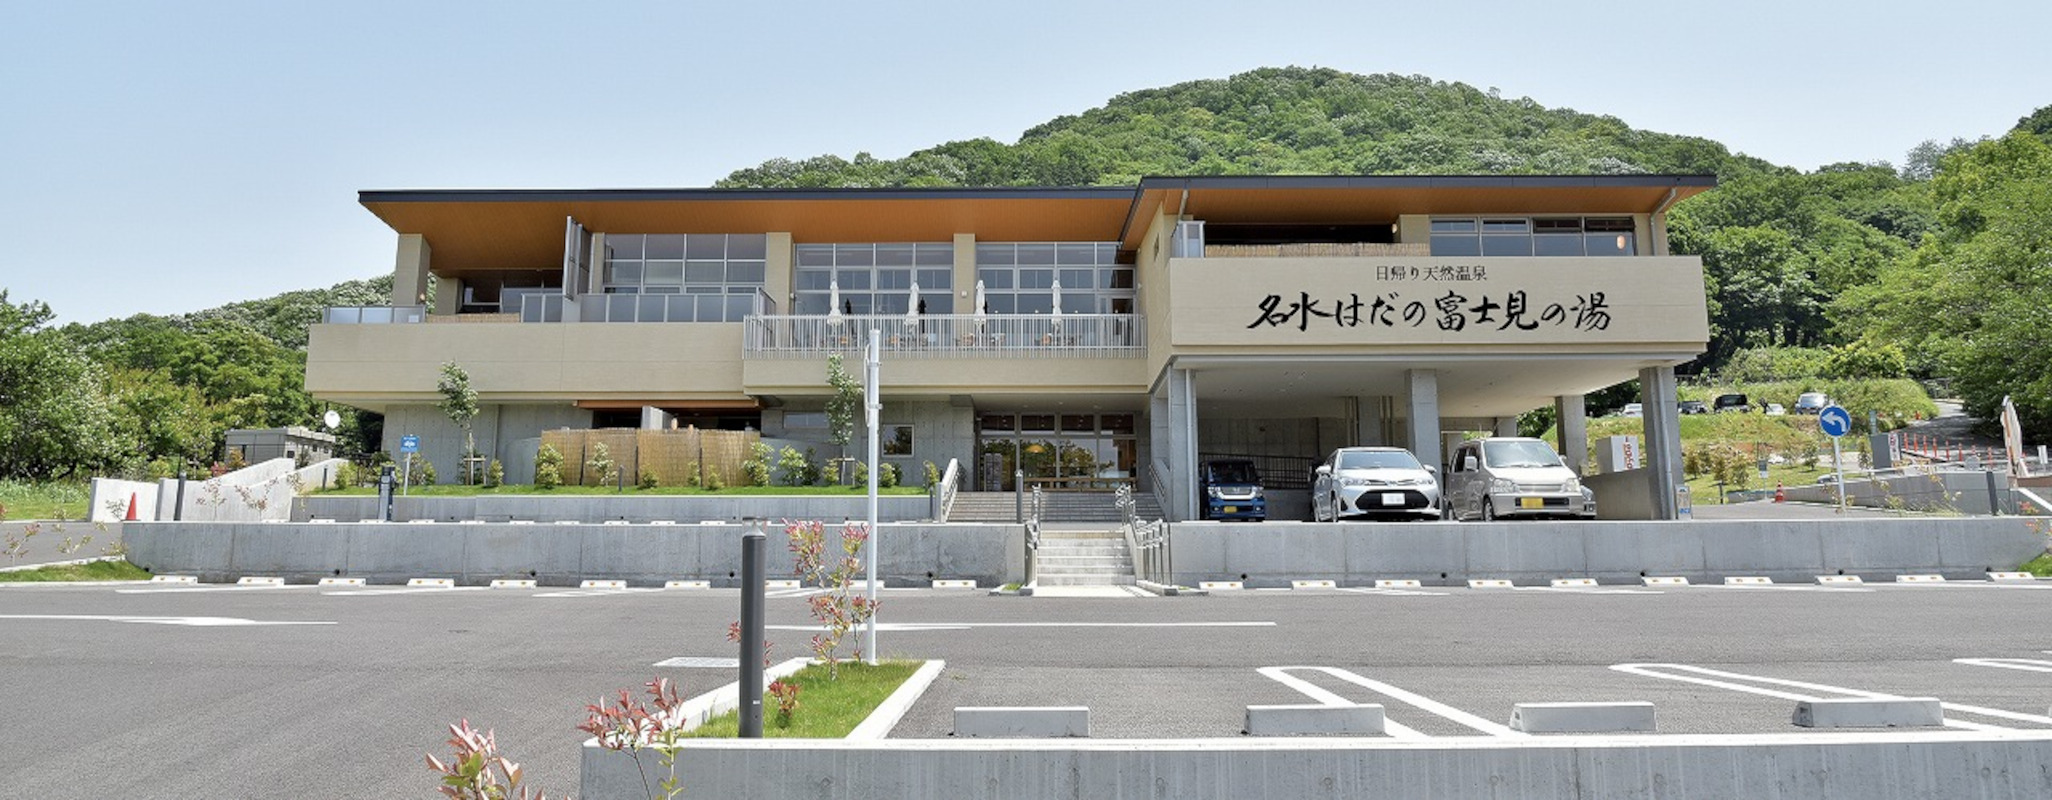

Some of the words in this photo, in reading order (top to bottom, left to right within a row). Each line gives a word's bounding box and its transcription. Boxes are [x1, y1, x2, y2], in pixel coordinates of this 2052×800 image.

[1376, 265, 1488, 281] 日帰り天然温泉
[1247, 290, 1611, 332] 名水はだの富士見の湯
